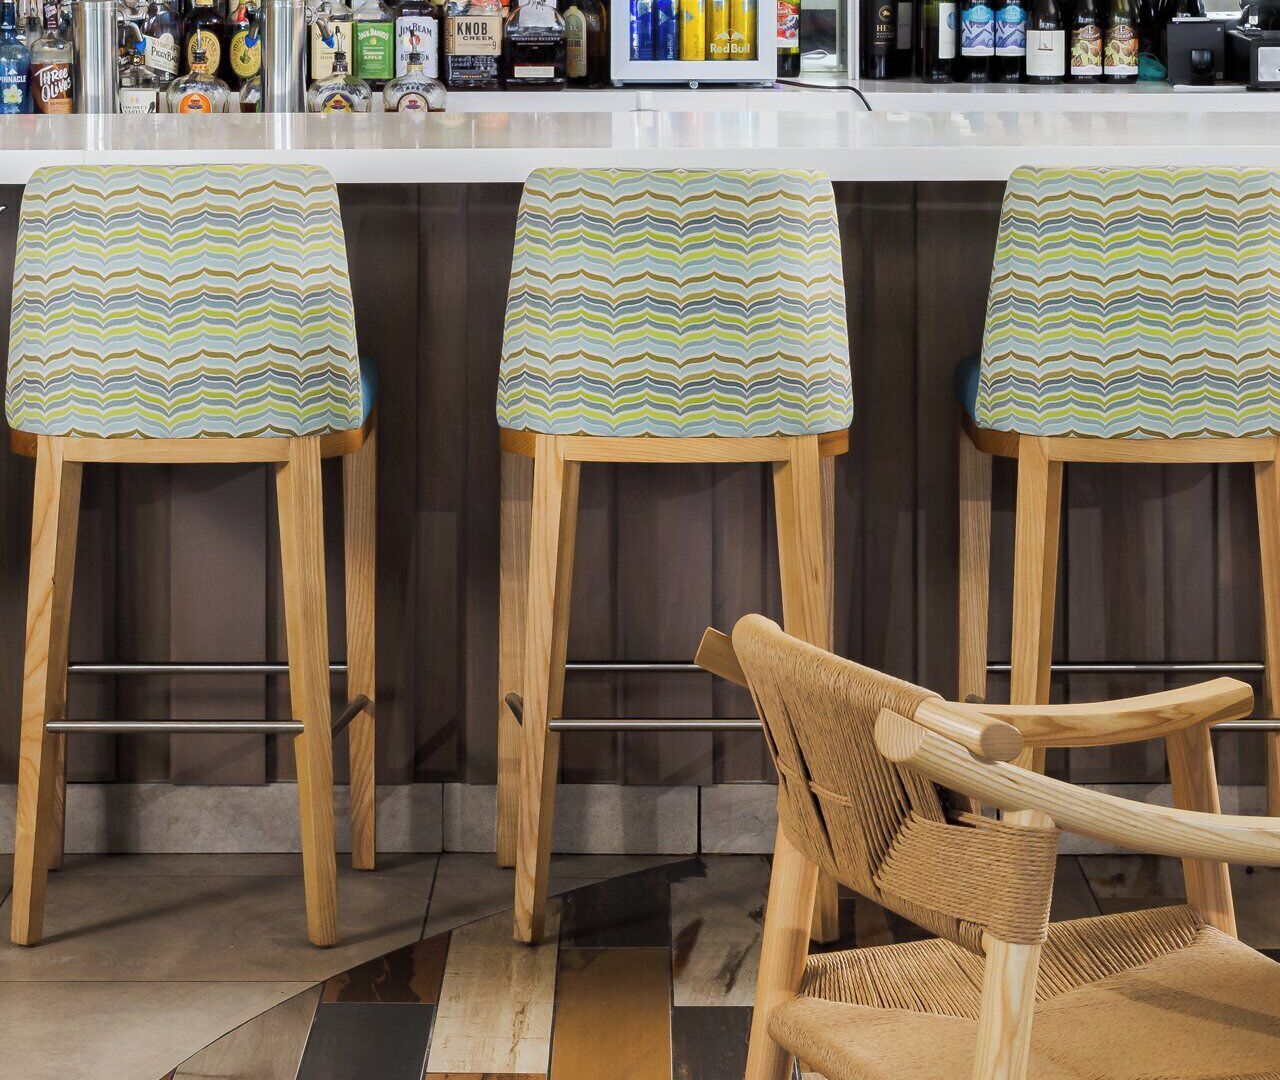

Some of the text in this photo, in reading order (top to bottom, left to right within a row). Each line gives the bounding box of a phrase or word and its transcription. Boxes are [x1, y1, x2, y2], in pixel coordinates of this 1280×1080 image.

[399, 23, 432, 38] JIM BEAM
[457, 22, 487, 35] KNOB
[710, 43, 750, 53] Red Bull
